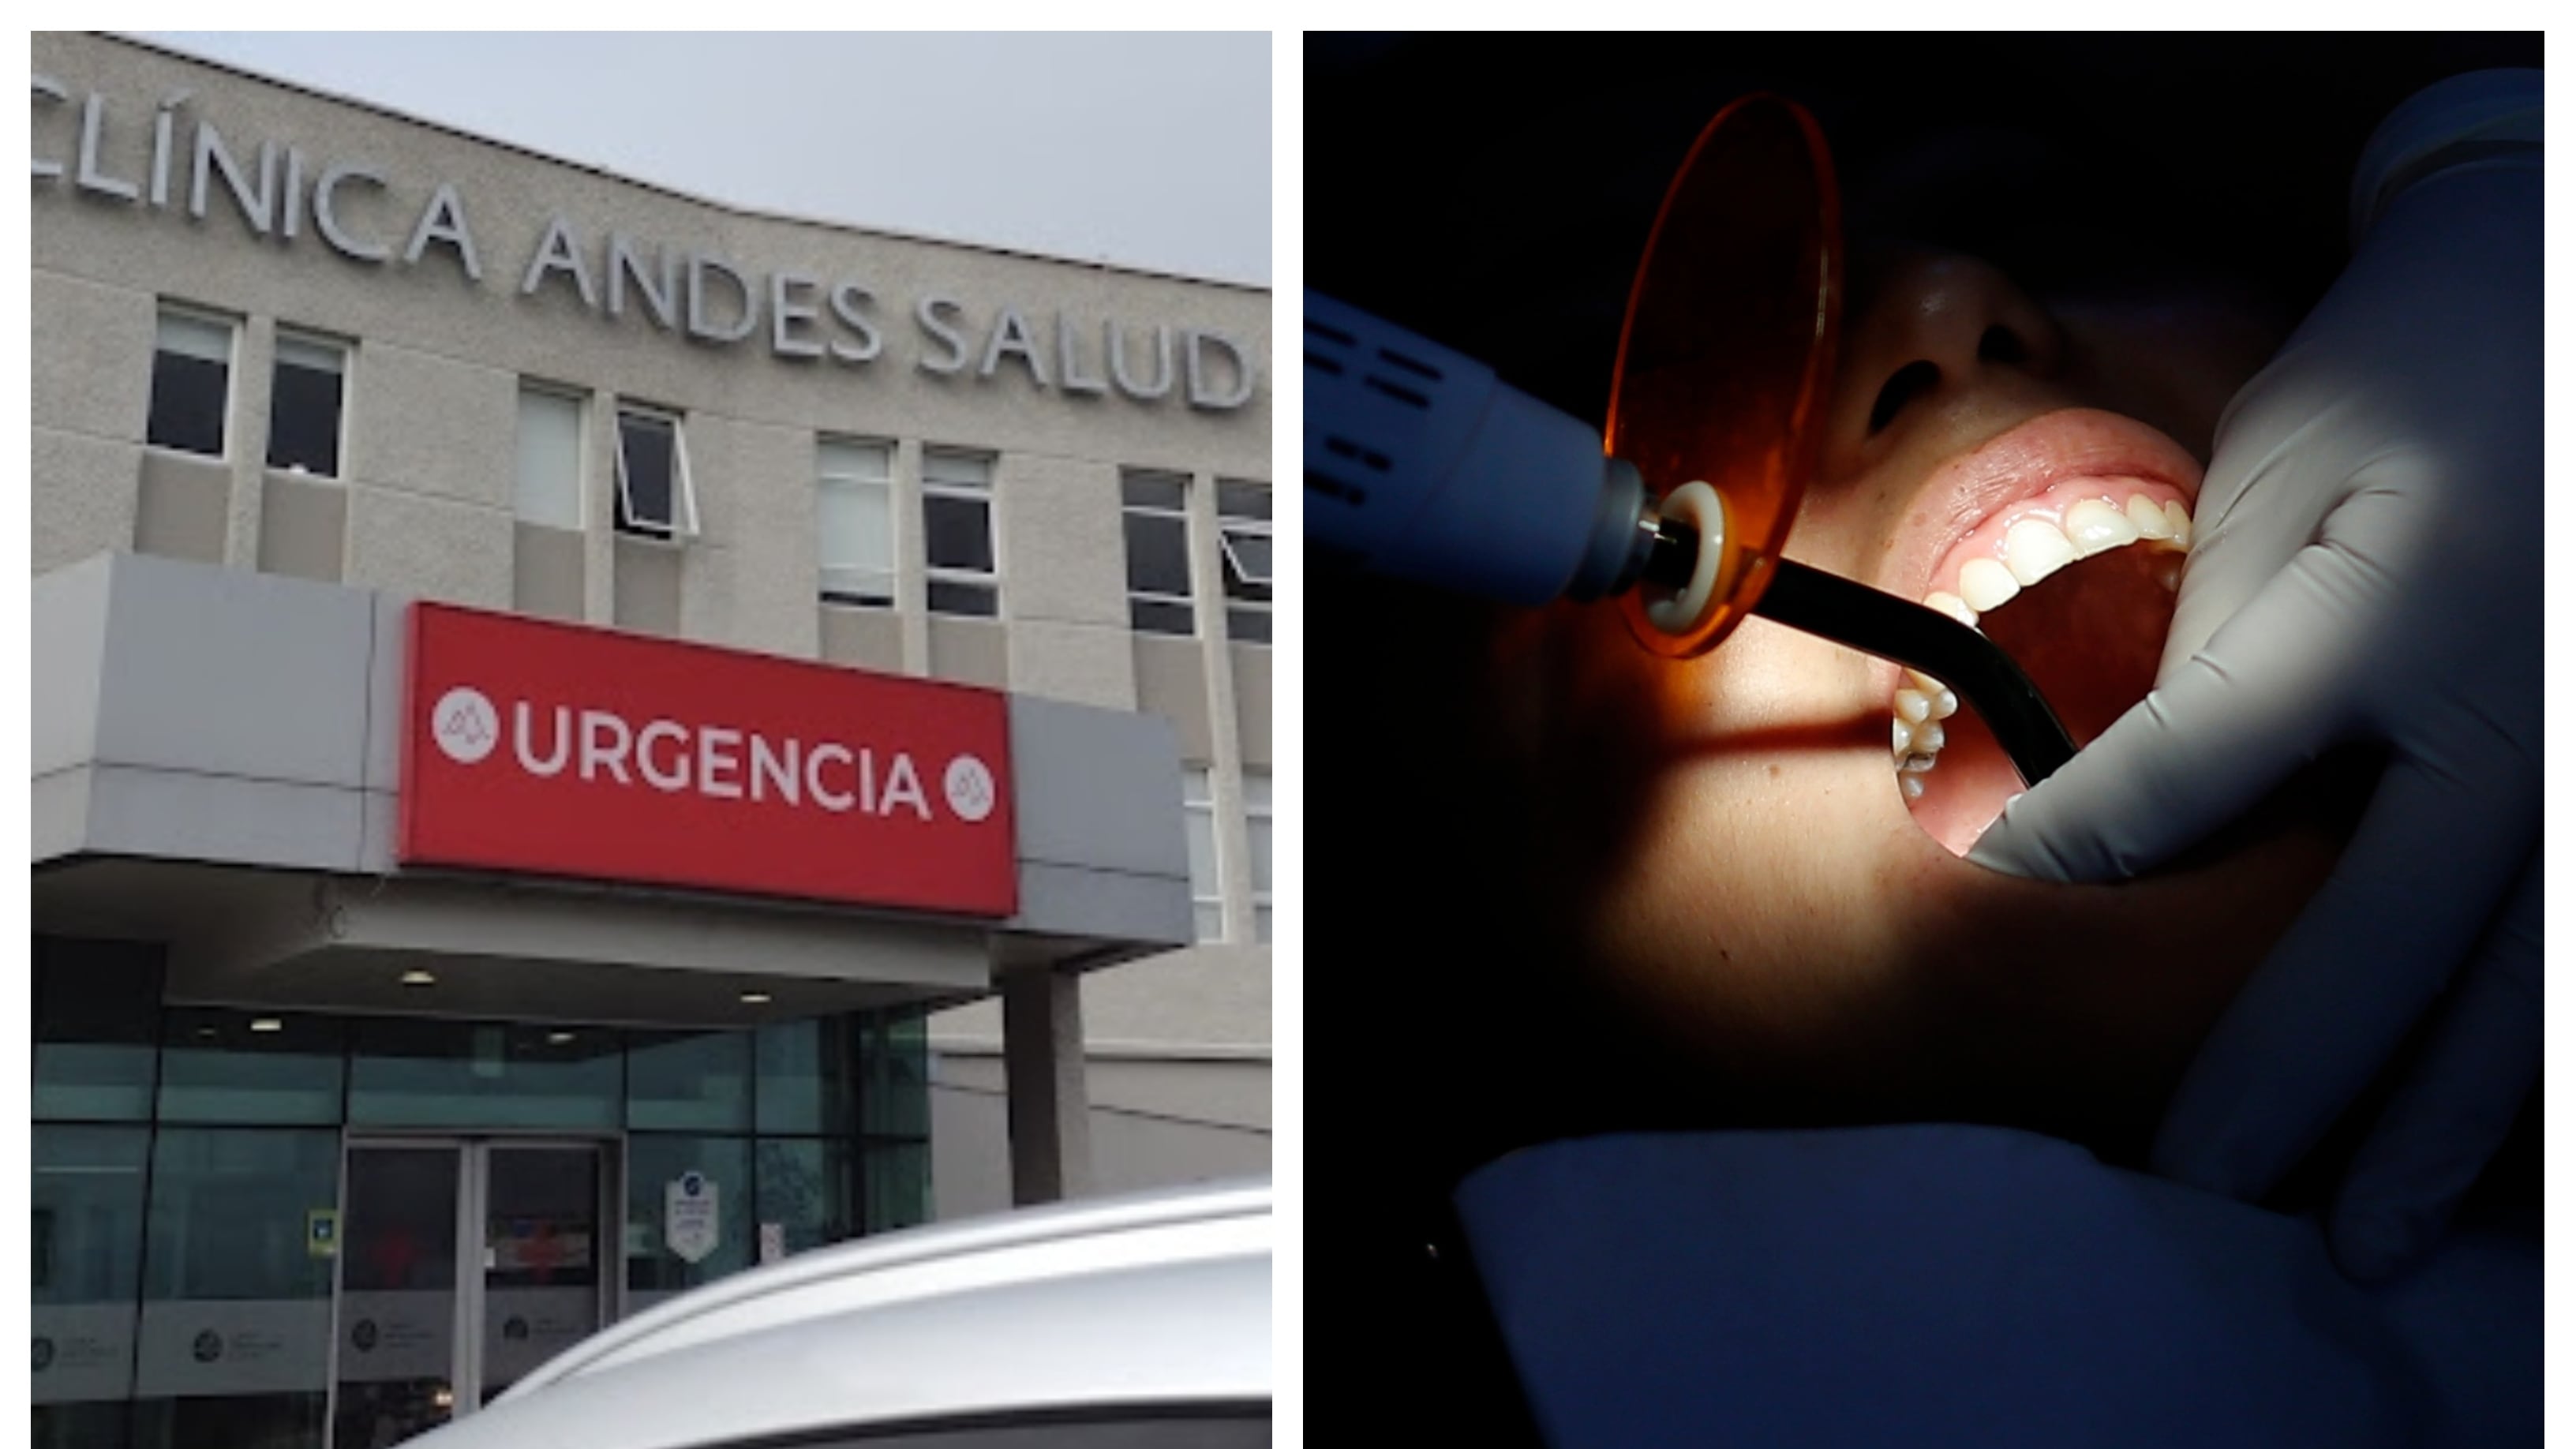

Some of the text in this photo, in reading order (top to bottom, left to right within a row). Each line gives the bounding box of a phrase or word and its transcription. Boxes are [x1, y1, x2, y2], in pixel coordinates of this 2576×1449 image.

[522, 212, 883, 363] ANDES
[915, 295, 1257, 410] SALUD
[512, 701, 933, 821] URGENCIA
